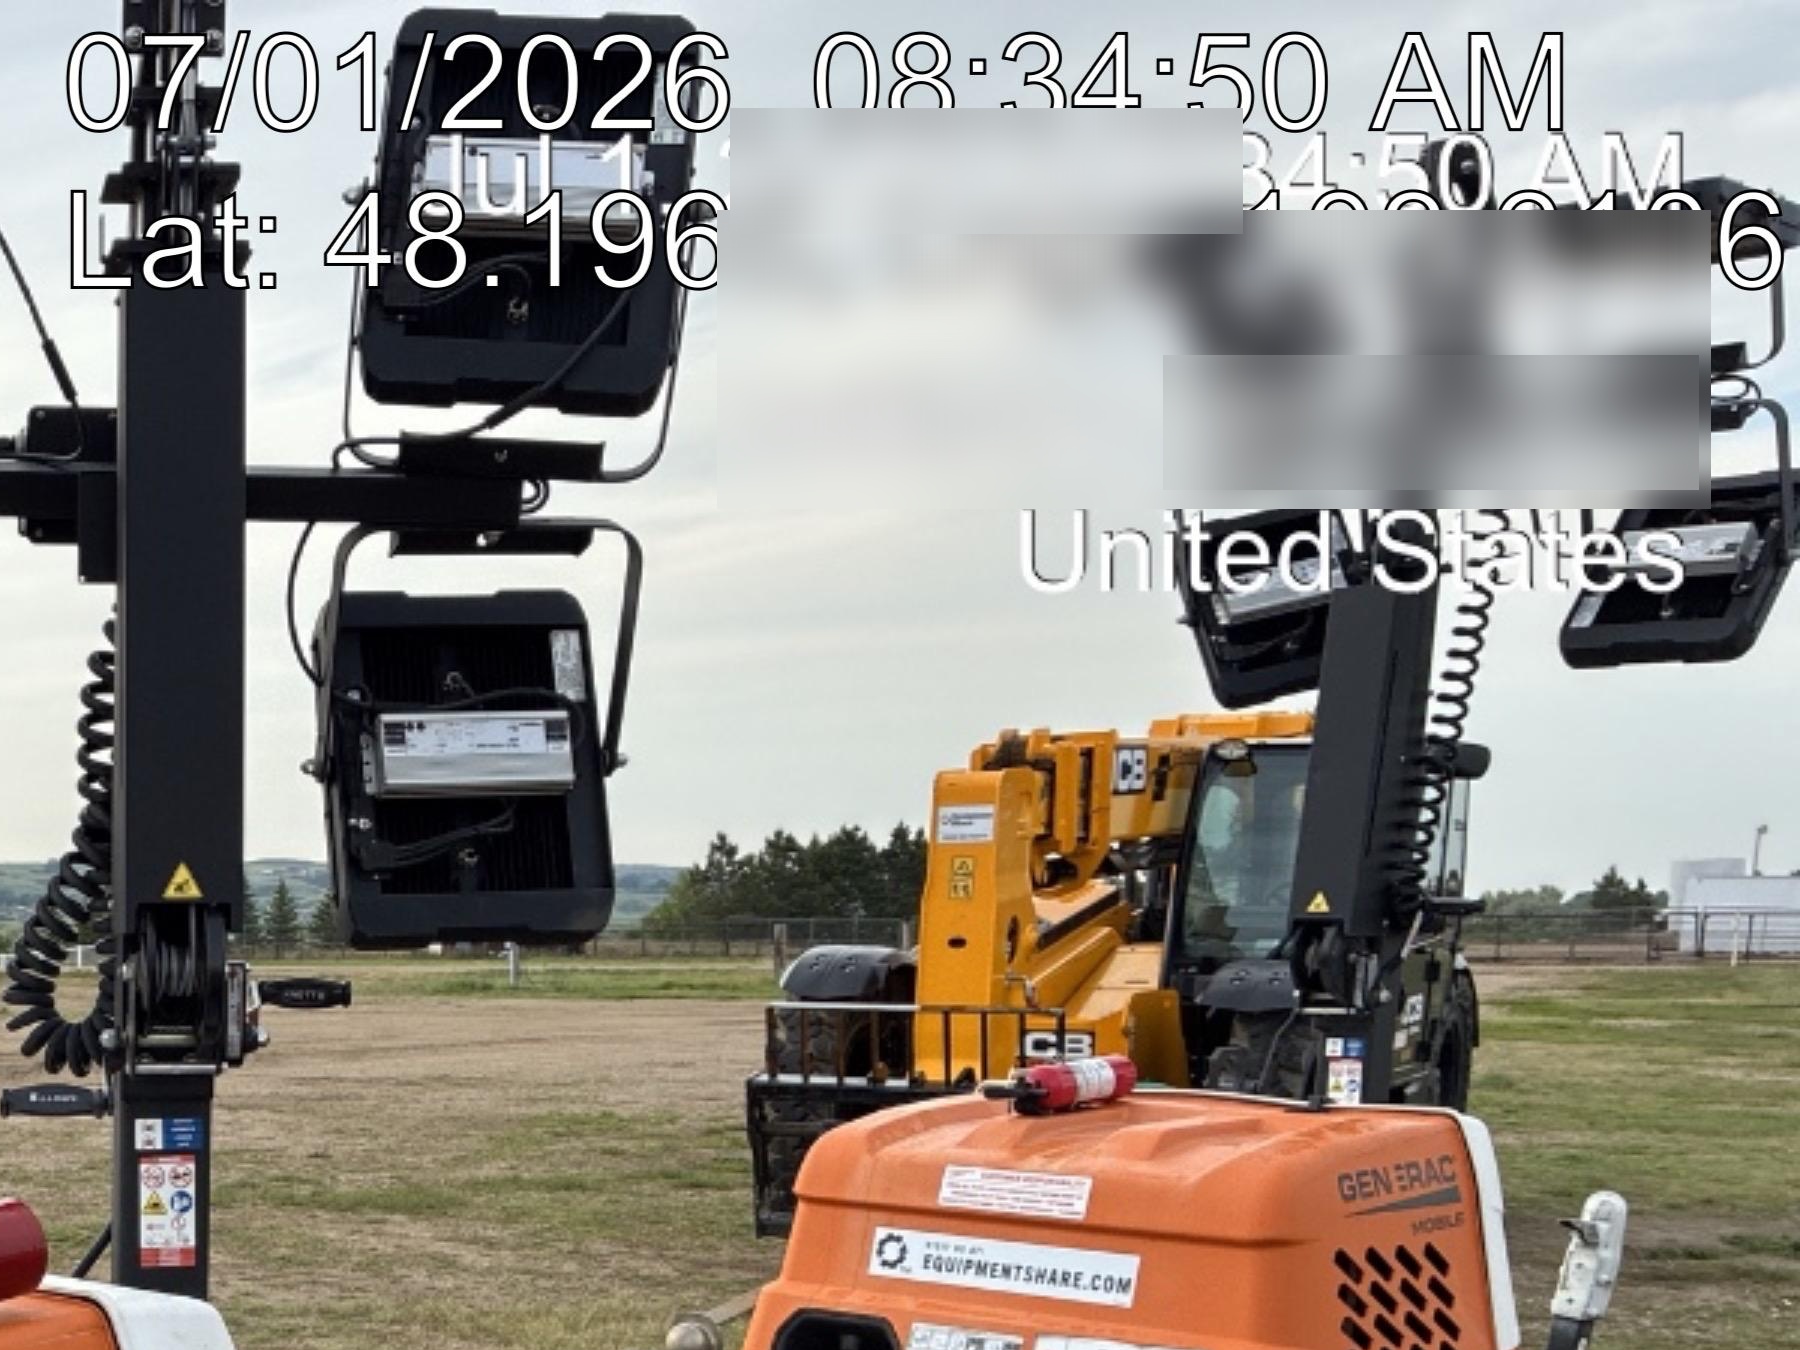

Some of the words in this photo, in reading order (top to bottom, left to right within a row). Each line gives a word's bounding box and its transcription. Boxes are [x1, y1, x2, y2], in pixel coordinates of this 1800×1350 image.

[1115, 750, 1147, 790] CB
[1025, 1031, 1093, 1058] CB
[922, 1253, 1132, 1295] EQUIPMENTSHARE.COM
